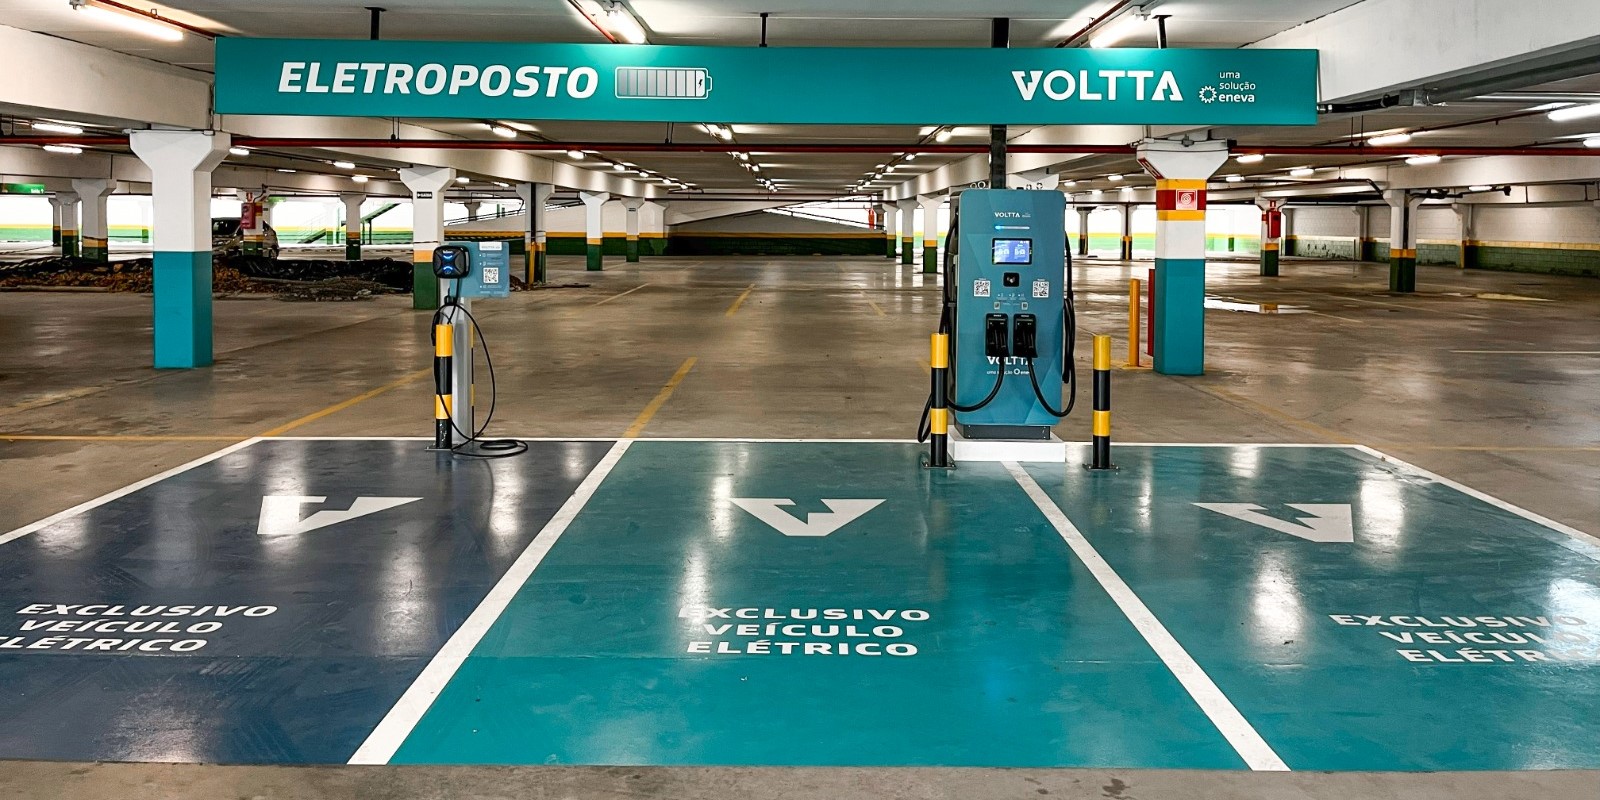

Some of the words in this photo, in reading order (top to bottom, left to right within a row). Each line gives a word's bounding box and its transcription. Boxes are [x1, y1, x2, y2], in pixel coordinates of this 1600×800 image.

[278, 61, 599, 99] ELETROPOSTO
[1011, 69, 1184, 101] VOLTTA
[1219, 81, 1256, 91] solução
[1218, 94, 1255, 103] eneva
[16, 603, 278, 617] EXCLUSIVO
[677, 608, 930, 621] EXCLUSIVO
[19, 618, 223, 634] VEÍCULO
[1328, 614, 1587, 627] EXCLUSIVO
[702, 622, 904, 638] VEÍCULO
[1378, 630, 1590, 644] VEÍCULO
[686, 639, 918, 656] ELÉTRICO
